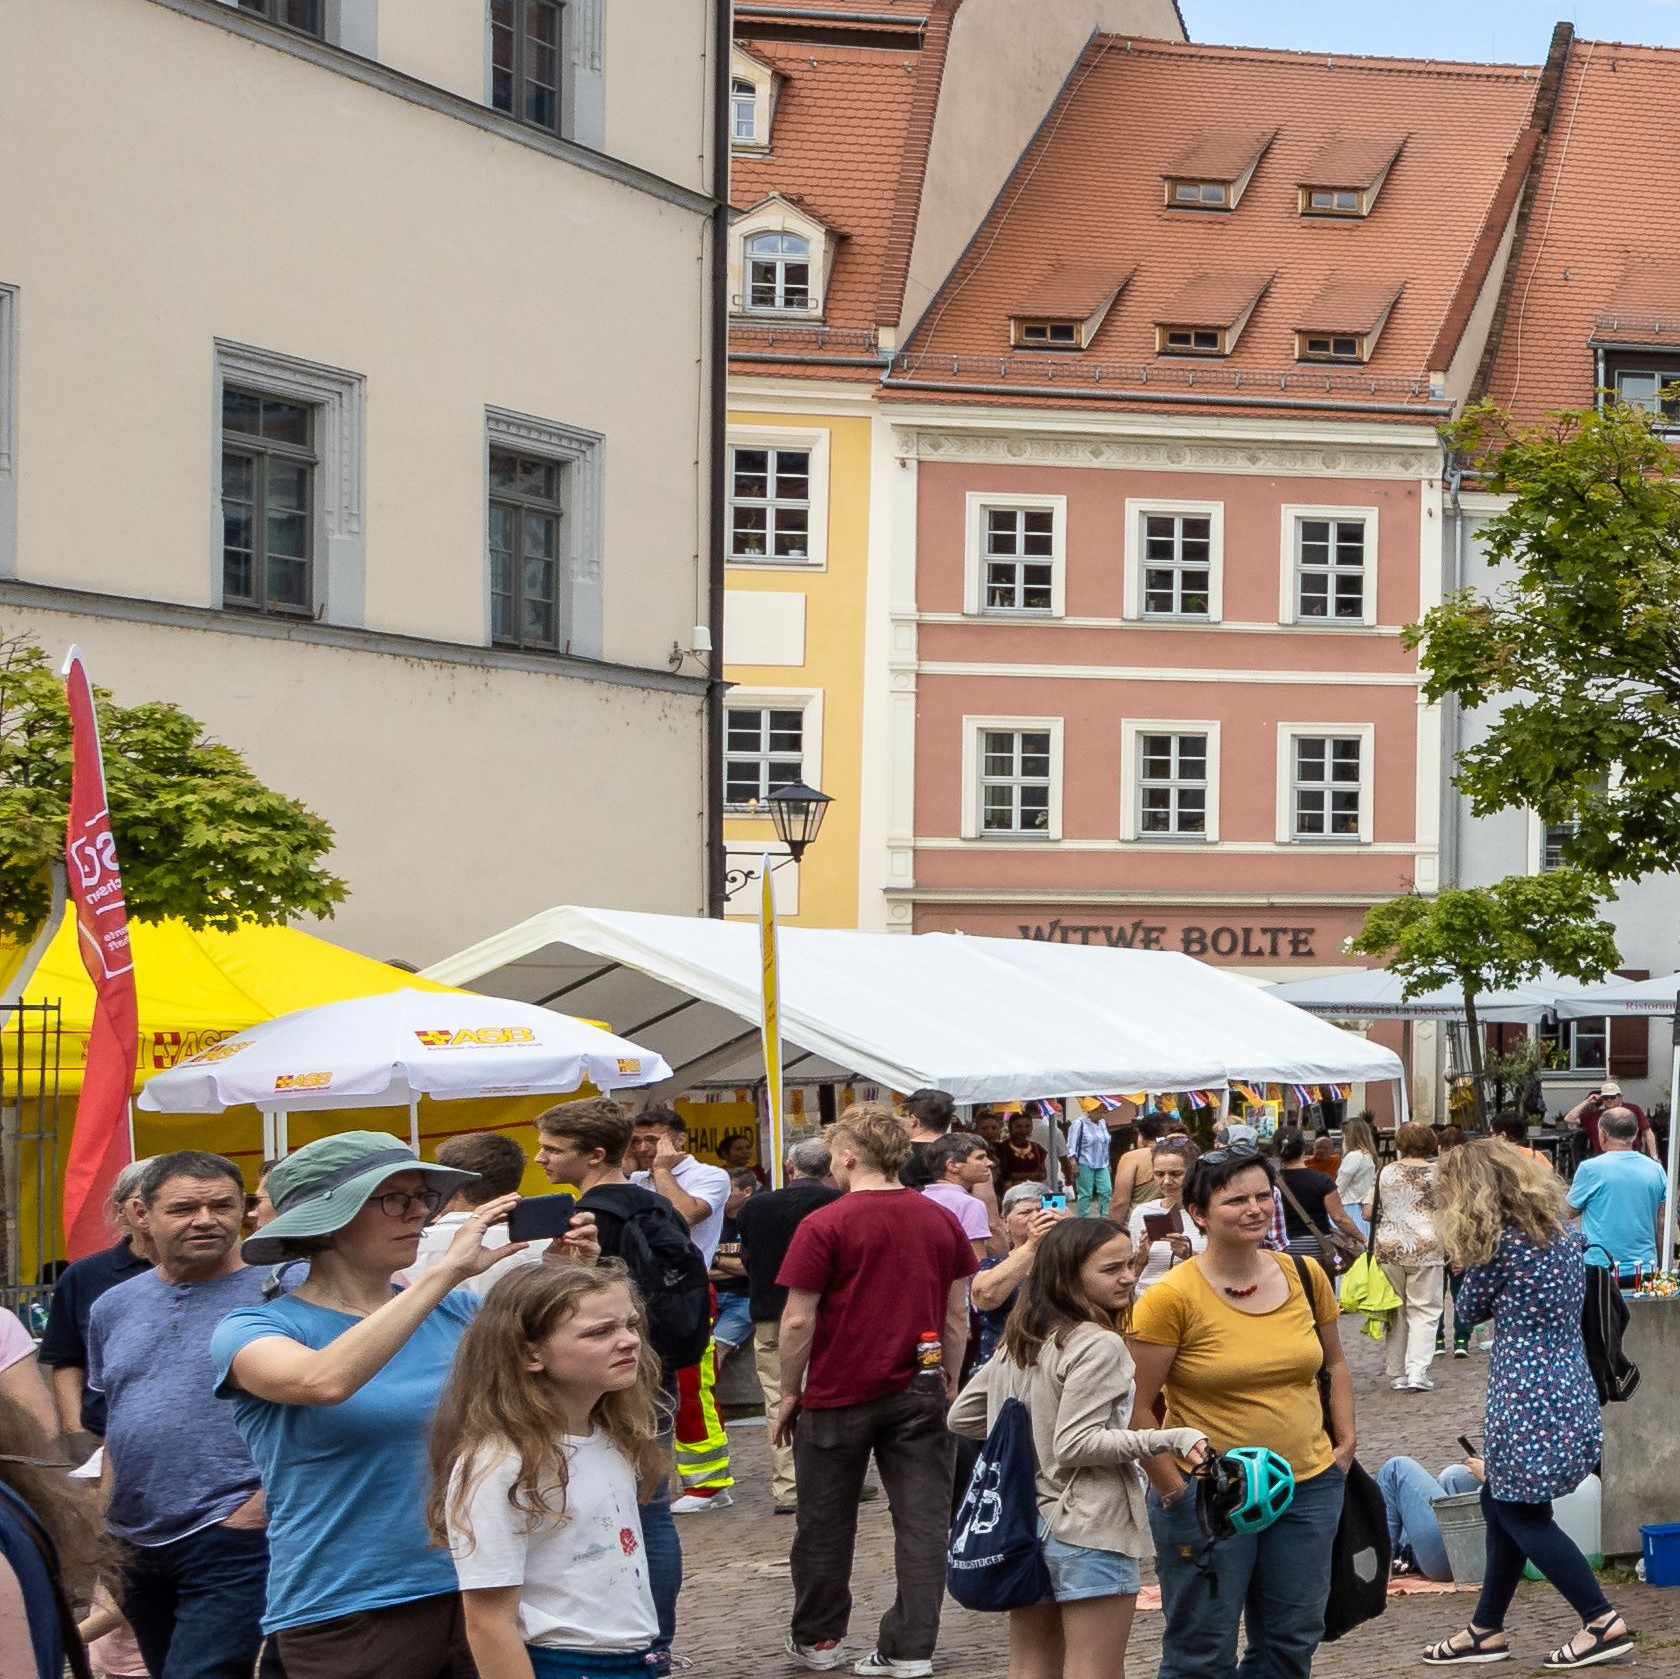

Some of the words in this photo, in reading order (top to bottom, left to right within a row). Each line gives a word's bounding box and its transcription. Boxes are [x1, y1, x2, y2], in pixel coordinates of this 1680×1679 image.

[1018, 919, 1167, 950] WITWE
[1181, 926, 1315, 957] BOLTE
[450, 1026, 536, 1046] ASB
[685, 1125, 755, 1154] HAILD
